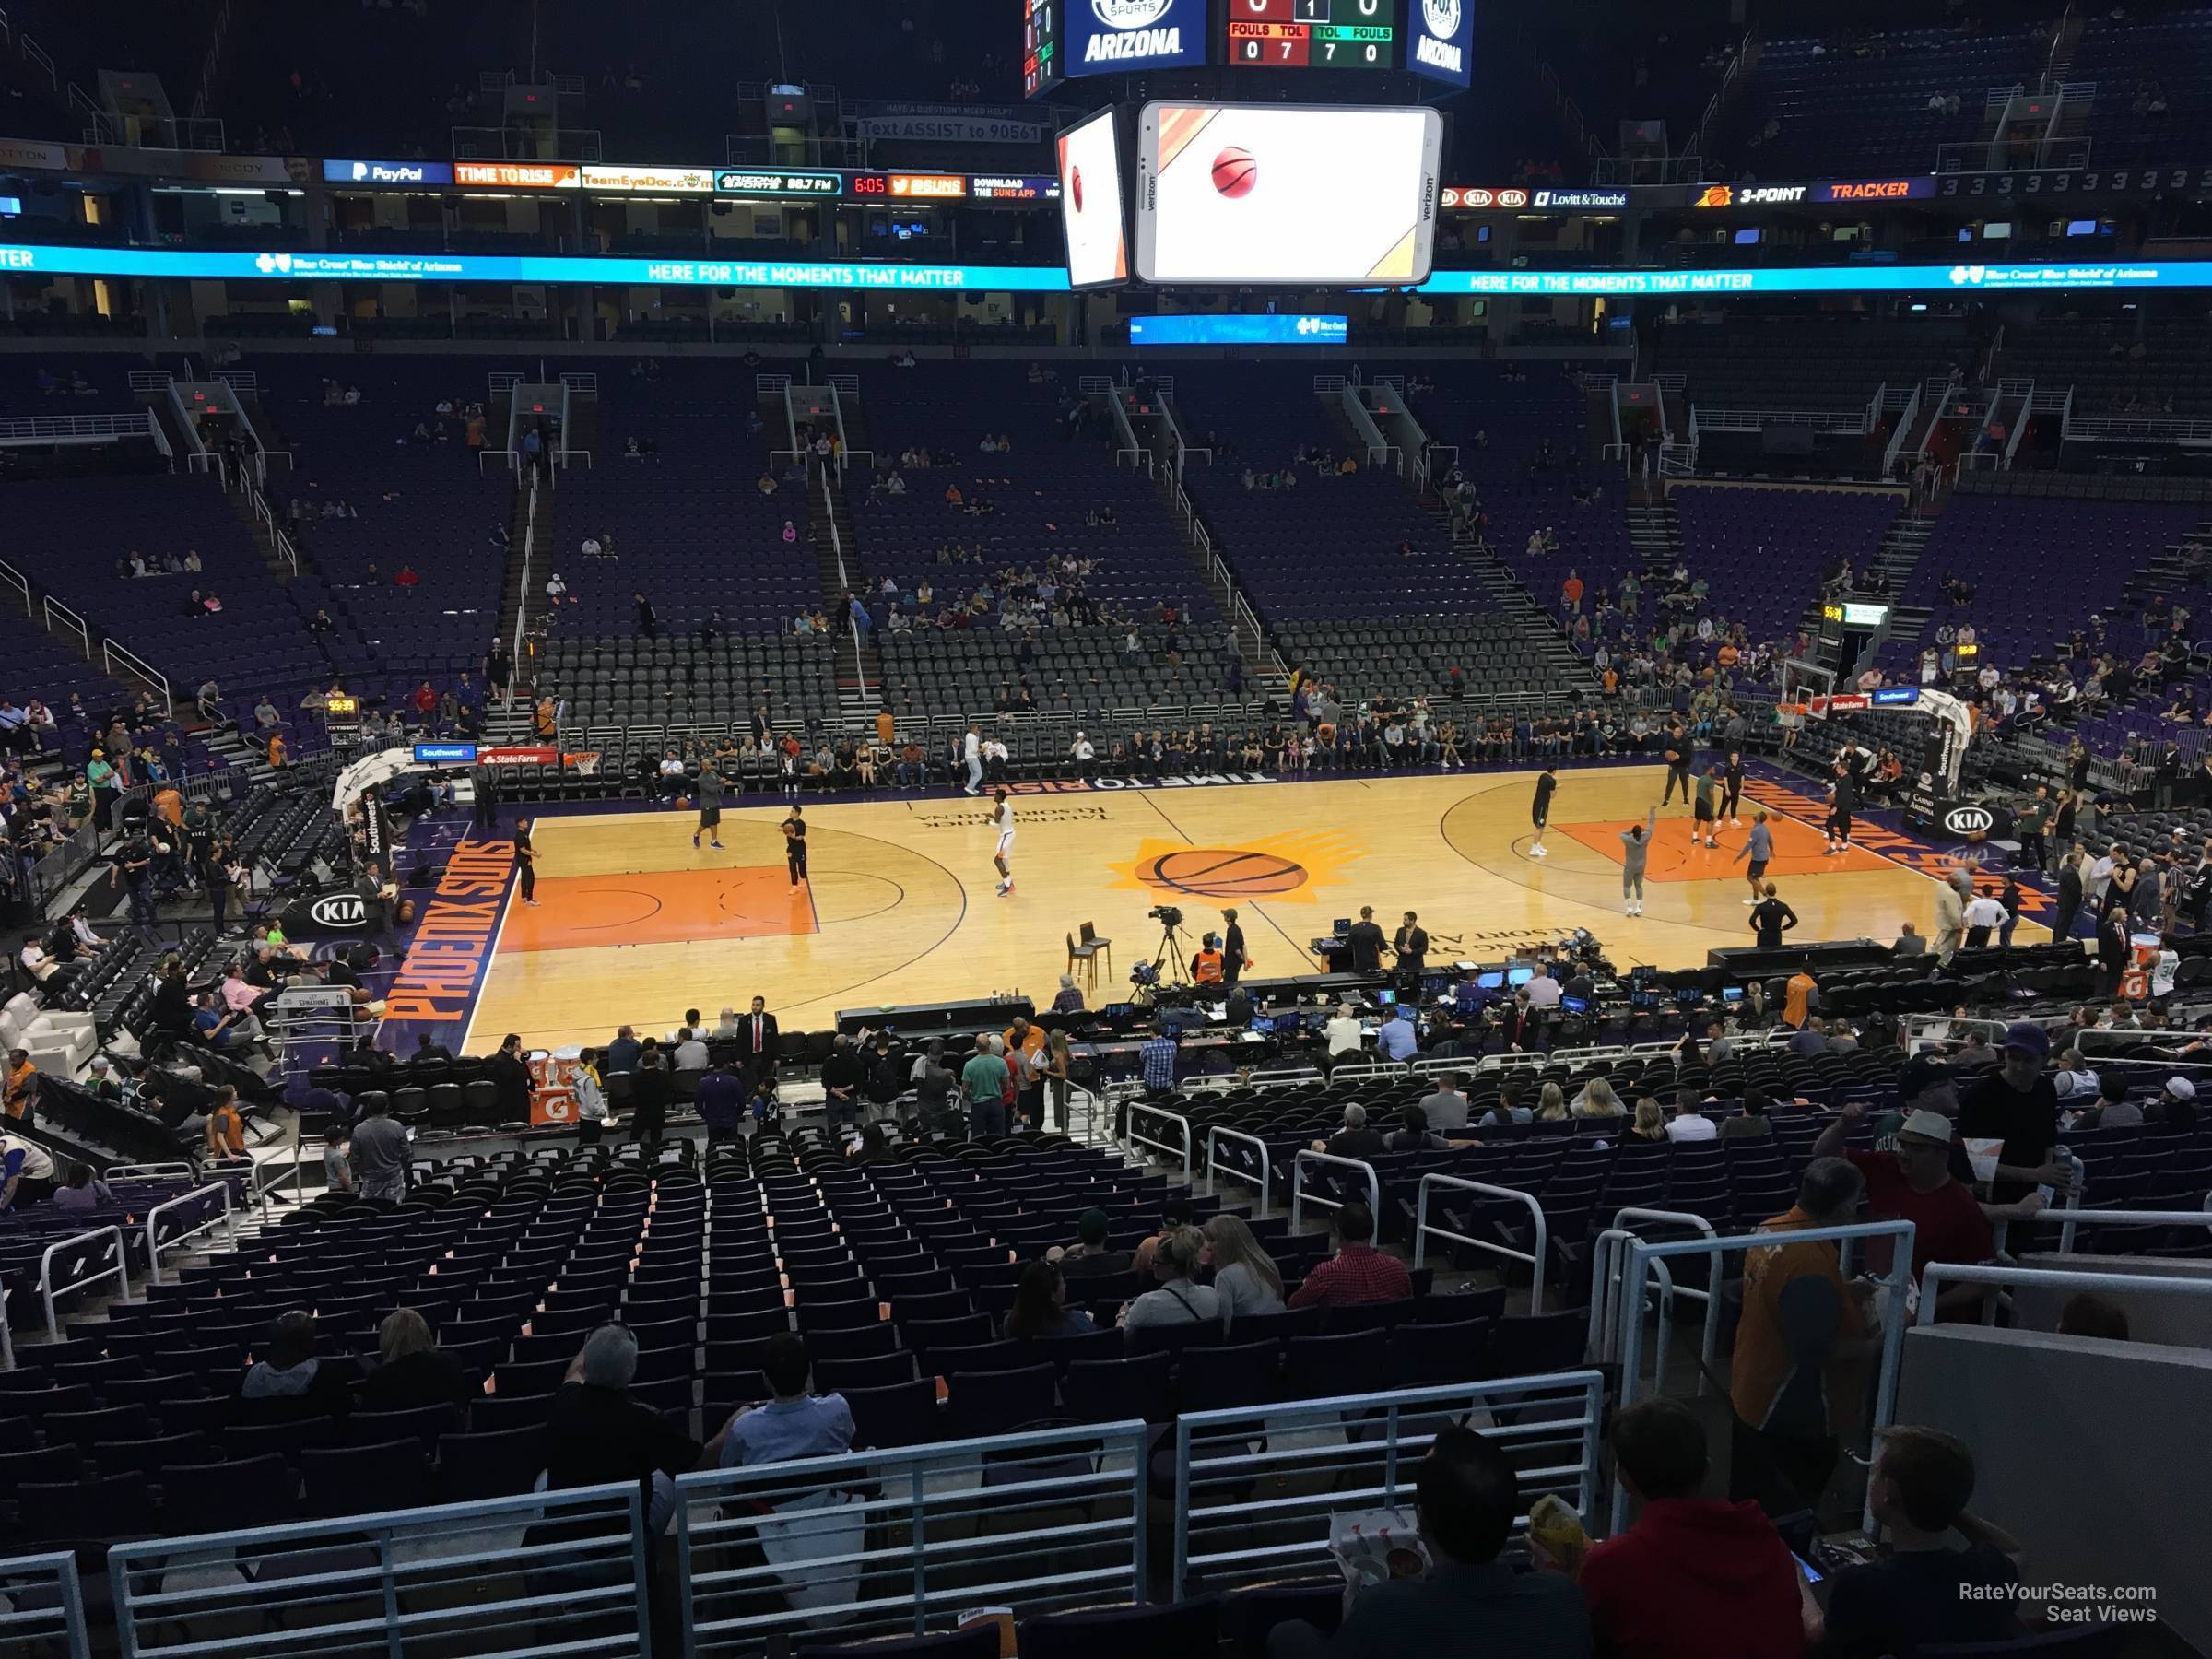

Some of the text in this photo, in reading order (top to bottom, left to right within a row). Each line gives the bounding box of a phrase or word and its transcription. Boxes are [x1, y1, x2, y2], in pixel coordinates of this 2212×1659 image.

[1111, 4, 1156, 16] SPORTS
[1232, 24, 1302, 37] FOULS TOL
[1319, 27, 1390, 39] TOL FOULS
[1247, 41, 1291, 59] 0 7
[1325, 43, 1376, 62] 7 0
[887, 104, 908, 112] HAVE
[917, 105, 962, 114] QUESTION?
[964, 107, 985, 115] NEED
[987, 108, 1013, 116] HELP?
[863, 121, 1039, 139] Text ASSIST to 90561
[373, 167, 422, 182] PayPal
[457, 167, 554, 183] TIME TO RISE
[815, 180, 831, 191] FM
[854, 178, 884, 193] 6:05
[974, 178, 1023, 188] DOWNLOAD
[1831, 182, 1909, 198] TRACKER
[1943, 180, 1958, 195] 3
[1970, 178, 1985, 194] 3
[1998, 177, 2013, 194] 3
[2026, 176, 2041, 192] 3
[2053, 174, 2069, 191] 3
[2083, 174, 2099, 190] 3
[2112, 172, 2128, 189] 3
[2141, 171, 2157, 188] 3
[2171, 171, 2187, 187] 3
[974, 187, 1035, 198] THE SUNS APP
[1147, 176, 1156, 211] verizon
[1423, 177, 1434, 221] verizon
[1469, 194, 1488, 203] KIA
[1503, 194, 1521, 203] KIA
[1552, 194, 1626, 205] Lovitt & Touché
[1740, 187, 1806, 203] 3-POINT
[649, 264, 963, 286] HERE FOR THE MOMENTS THAT MATTER
[1471, 273, 1752, 290] HERE FOR THE MOMENTS THAT MATTER
[1879, 692, 1909, 700] Southwest
[422, 748, 464, 758] Southwest
[1938, 731, 1952, 776] Southwest
[982, 771, 1277, 794] TIME TO RISE
[367, 801, 380, 853] Southwest
[1953, 813, 1984, 829] KIA
[323, 900, 365, 921] KIA
[380, 841, 516, 1021] PHOENIX SUNS
[2126, 977, 2142, 995] G
[546, 1096, 568, 1119] G
